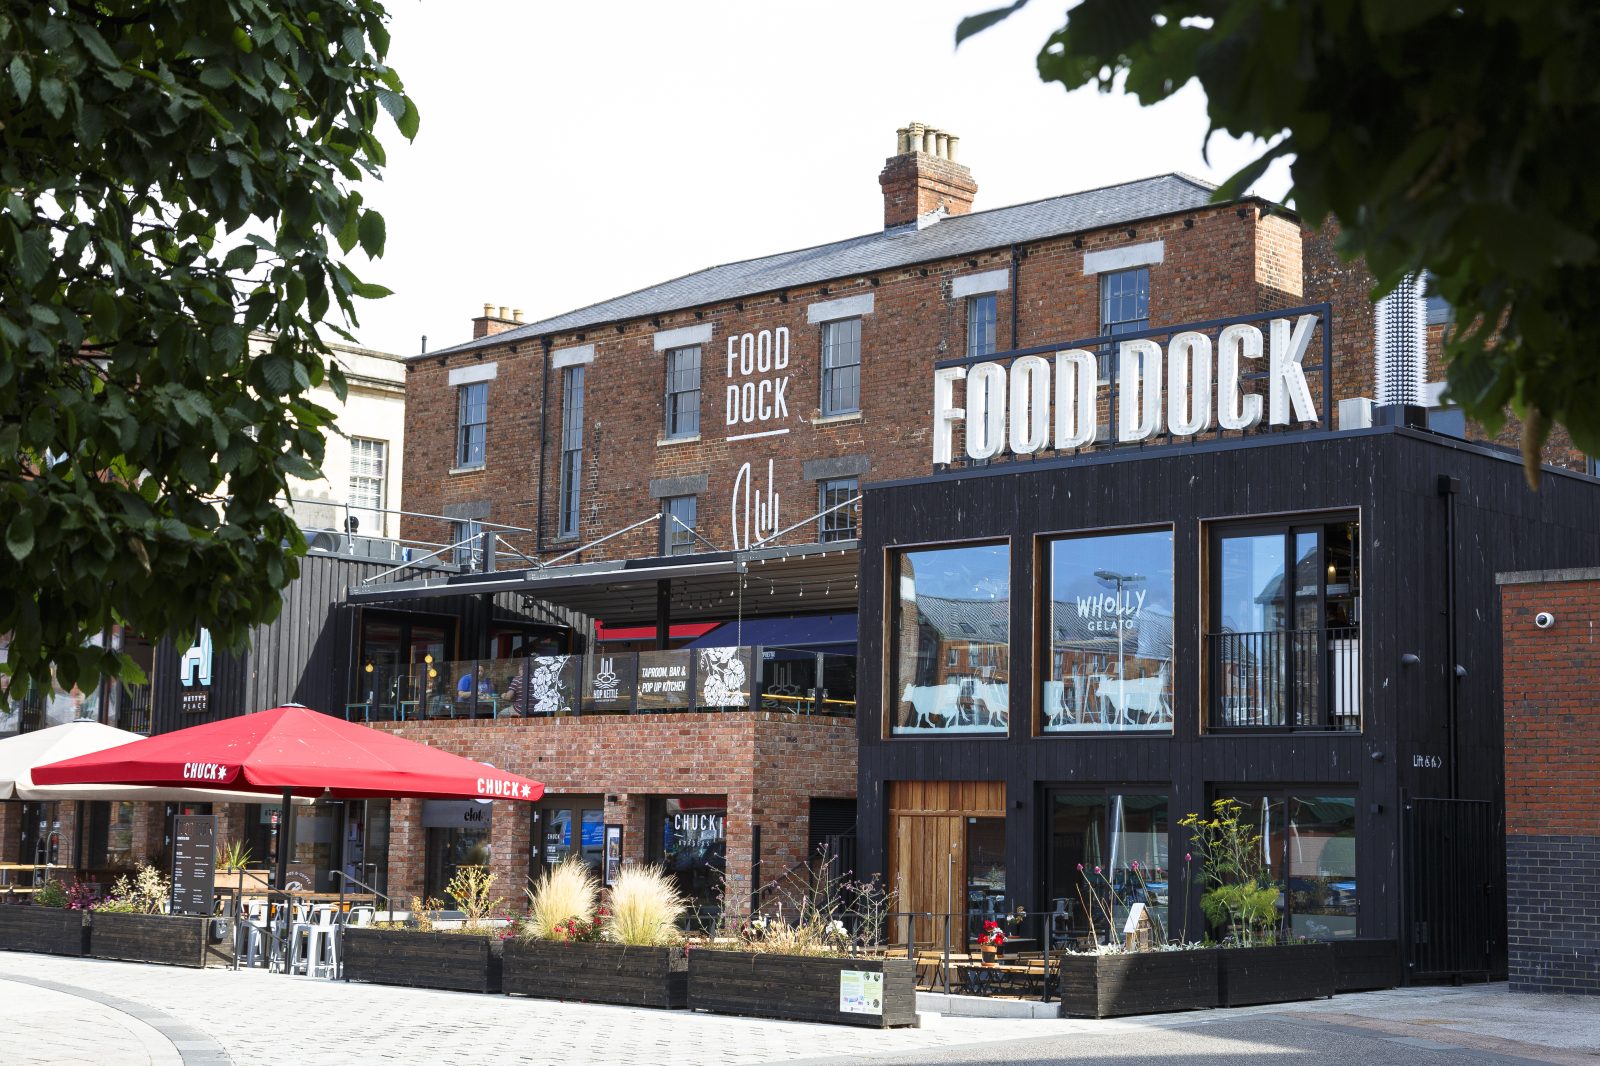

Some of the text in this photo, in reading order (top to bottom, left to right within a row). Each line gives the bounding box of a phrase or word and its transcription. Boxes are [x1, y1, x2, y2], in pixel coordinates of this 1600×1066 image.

[727, 326, 789, 378] FOOD
[933, 313, 1320, 465] FOOD DOCK
[726, 376, 789, 425] DOCK
[1076, 589, 1147, 619] WHOLLY
[1087, 619, 1134, 631] GELATO
[642, 666, 687, 678] TAPROOM, BAR &
[603, 689, 618, 698] KETTLE
[642, 681, 686, 693] POP UP KITCHEN
[183, 702, 206, 710] PLACE
[183, 762, 218, 780] CHUCK
[477, 778, 519, 797] CHUCK
[674, 814, 716, 831] CHUCK
